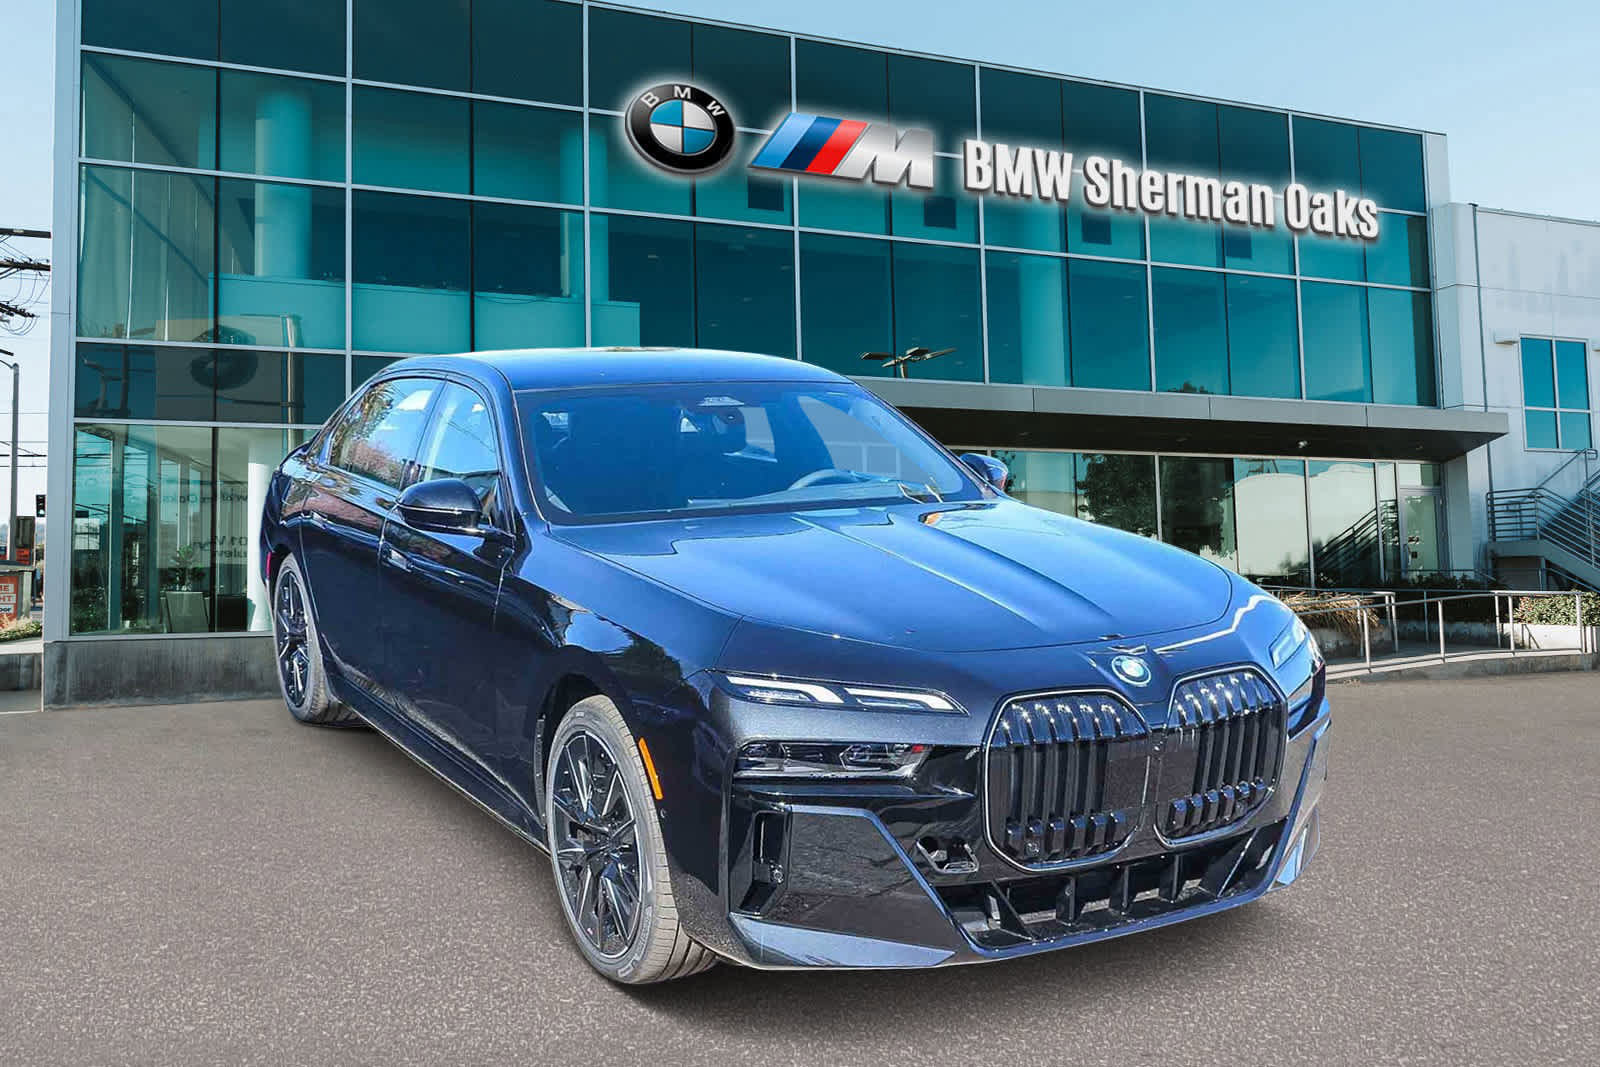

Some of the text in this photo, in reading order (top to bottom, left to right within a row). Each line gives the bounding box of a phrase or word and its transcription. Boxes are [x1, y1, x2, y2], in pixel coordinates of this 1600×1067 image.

[641, 84, 725, 118] BMW
[831, 121, 935, 190] M
[963, 139, 1379, 240] BMW Sherman Oaks
